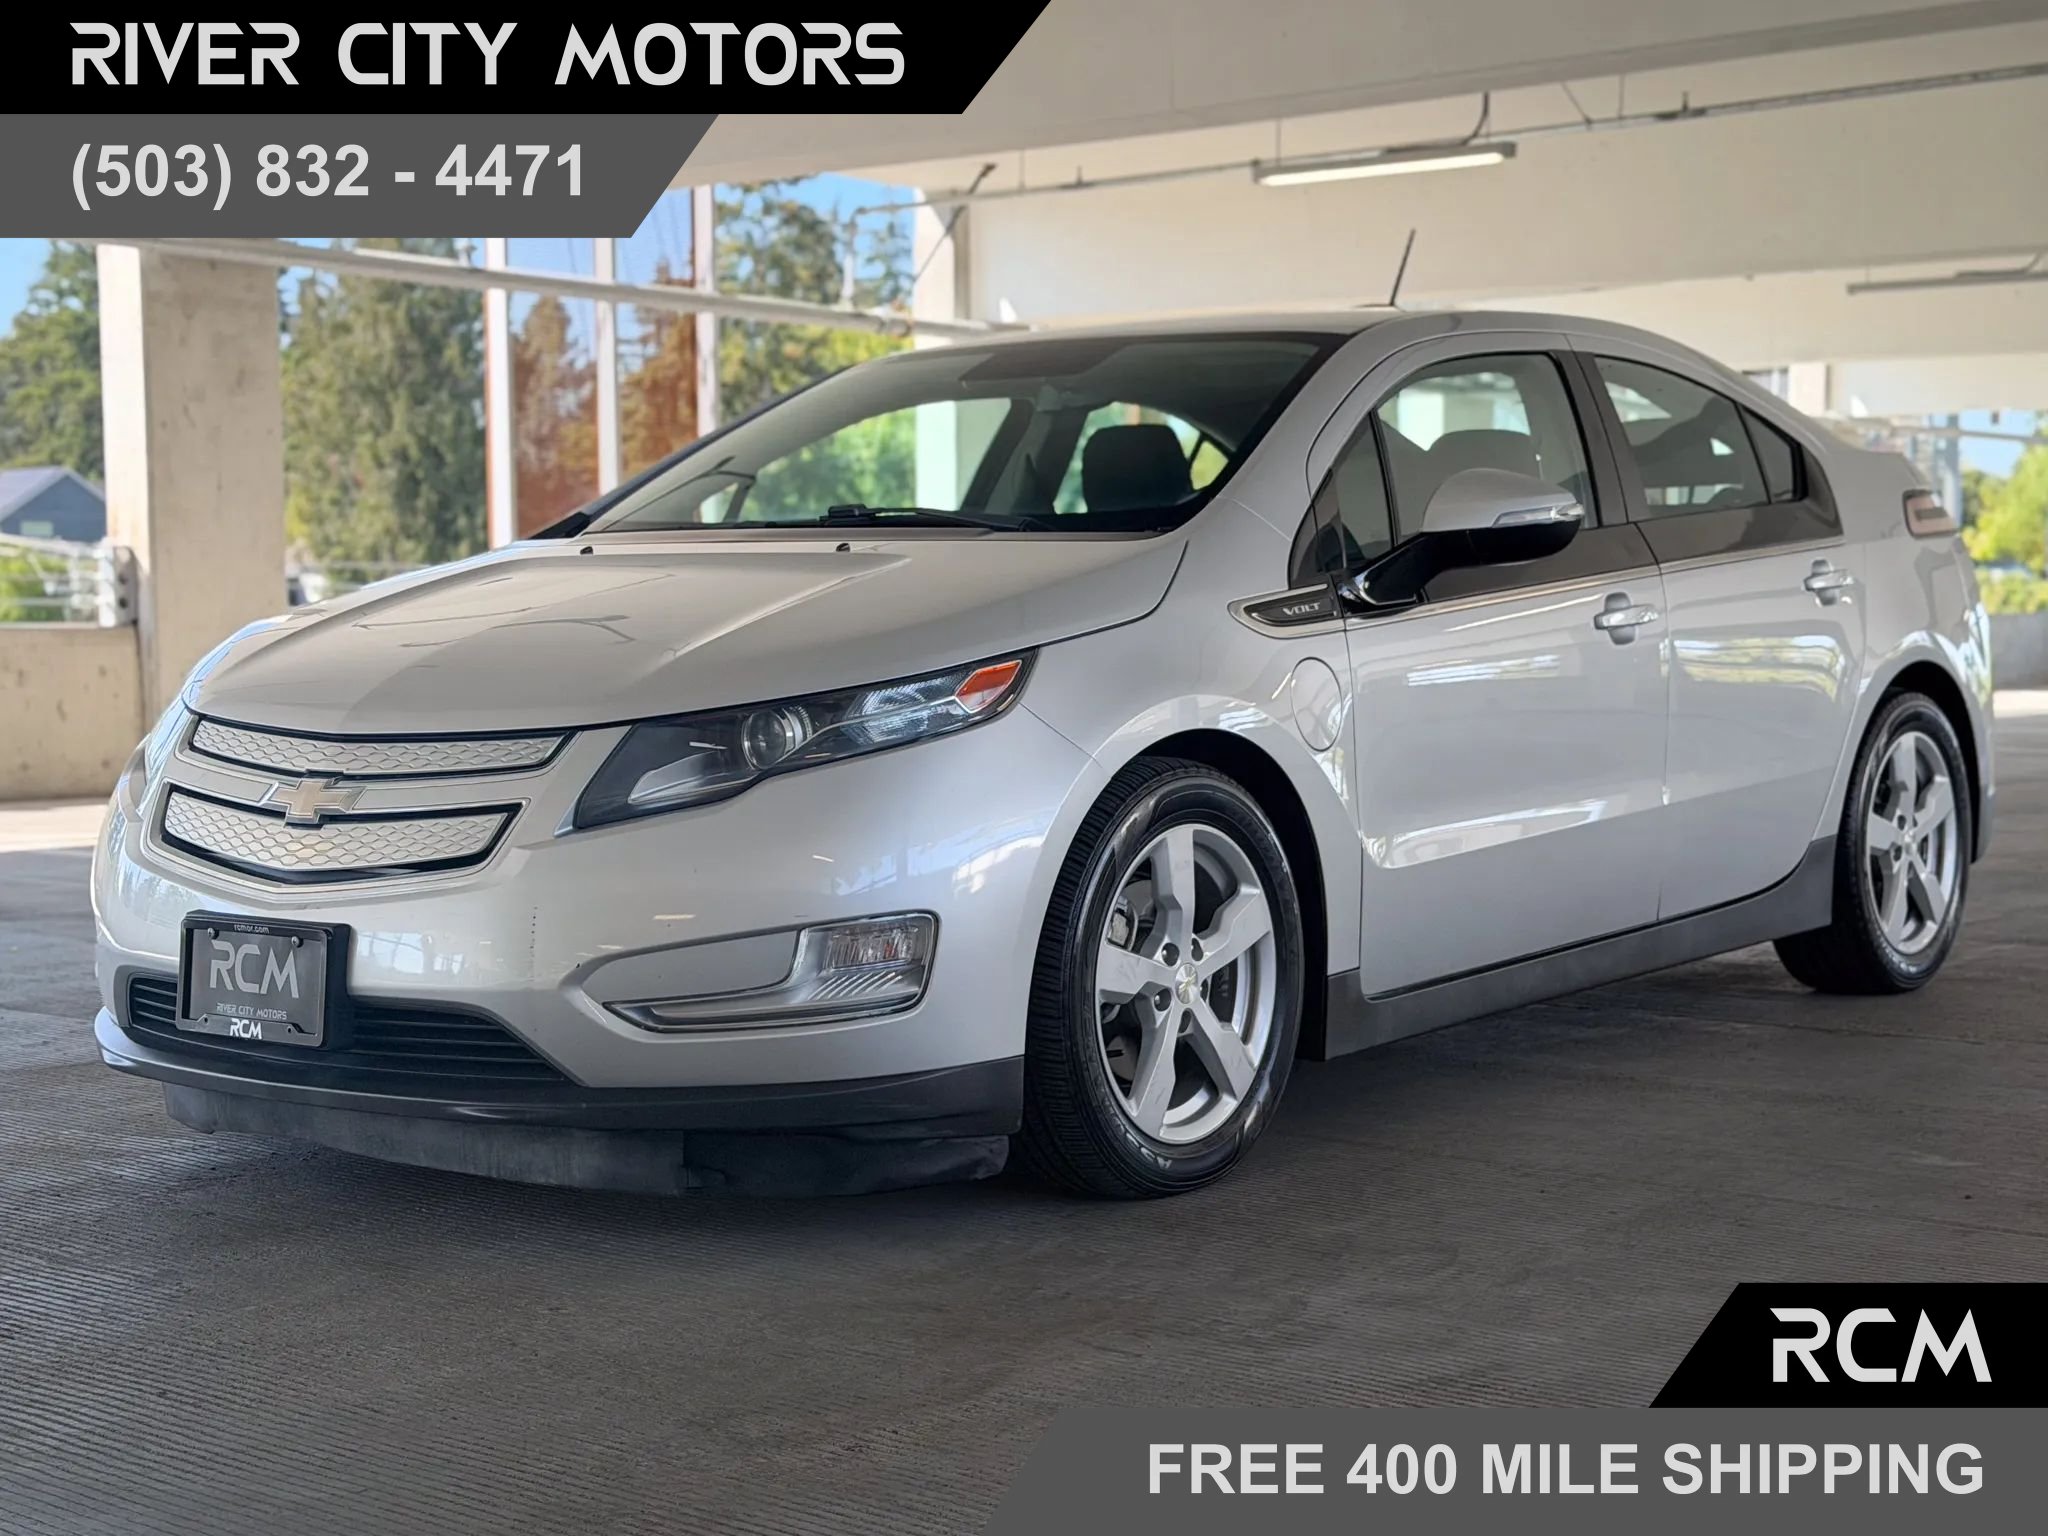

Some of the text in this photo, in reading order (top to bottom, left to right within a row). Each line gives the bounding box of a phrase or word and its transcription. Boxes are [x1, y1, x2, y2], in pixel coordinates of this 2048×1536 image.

[1282, 602, 1321, 616] VOLT
[210, 940, 299, 998] RCM
[216, 1003, 288, 1019] RIVER CITY MOTORS
[230, 1018, 262, 1039] RCM
